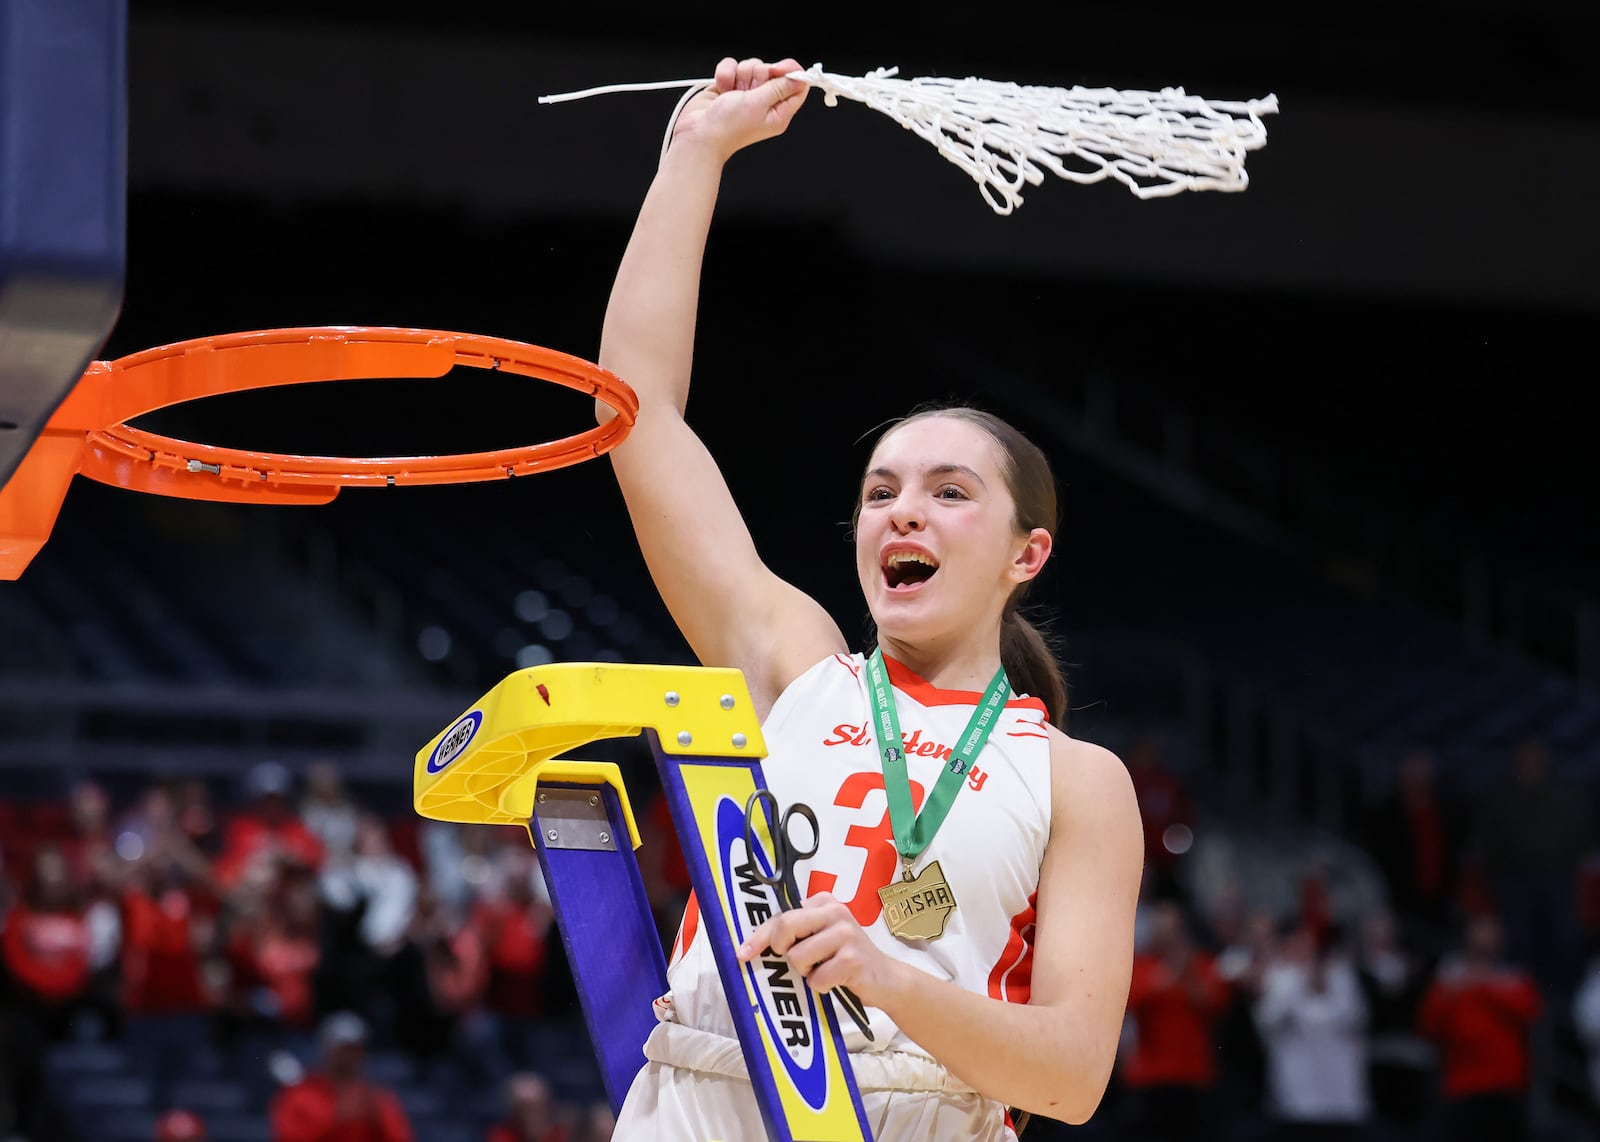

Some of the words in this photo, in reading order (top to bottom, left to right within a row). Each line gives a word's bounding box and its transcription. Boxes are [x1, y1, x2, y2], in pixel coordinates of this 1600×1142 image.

[877, 687, 888, 710] ATHLETIC
[881, 710, 894, 742] ASSOCIATION
[977, 707, 994, 727] ATHLETIC
[437, 720, 473, 764] WERNER
[961, 727, 983, 756] ASSOCIATION
[807, 771, 925, 927] 3
[888, 887, 951, 926] OHSAA
